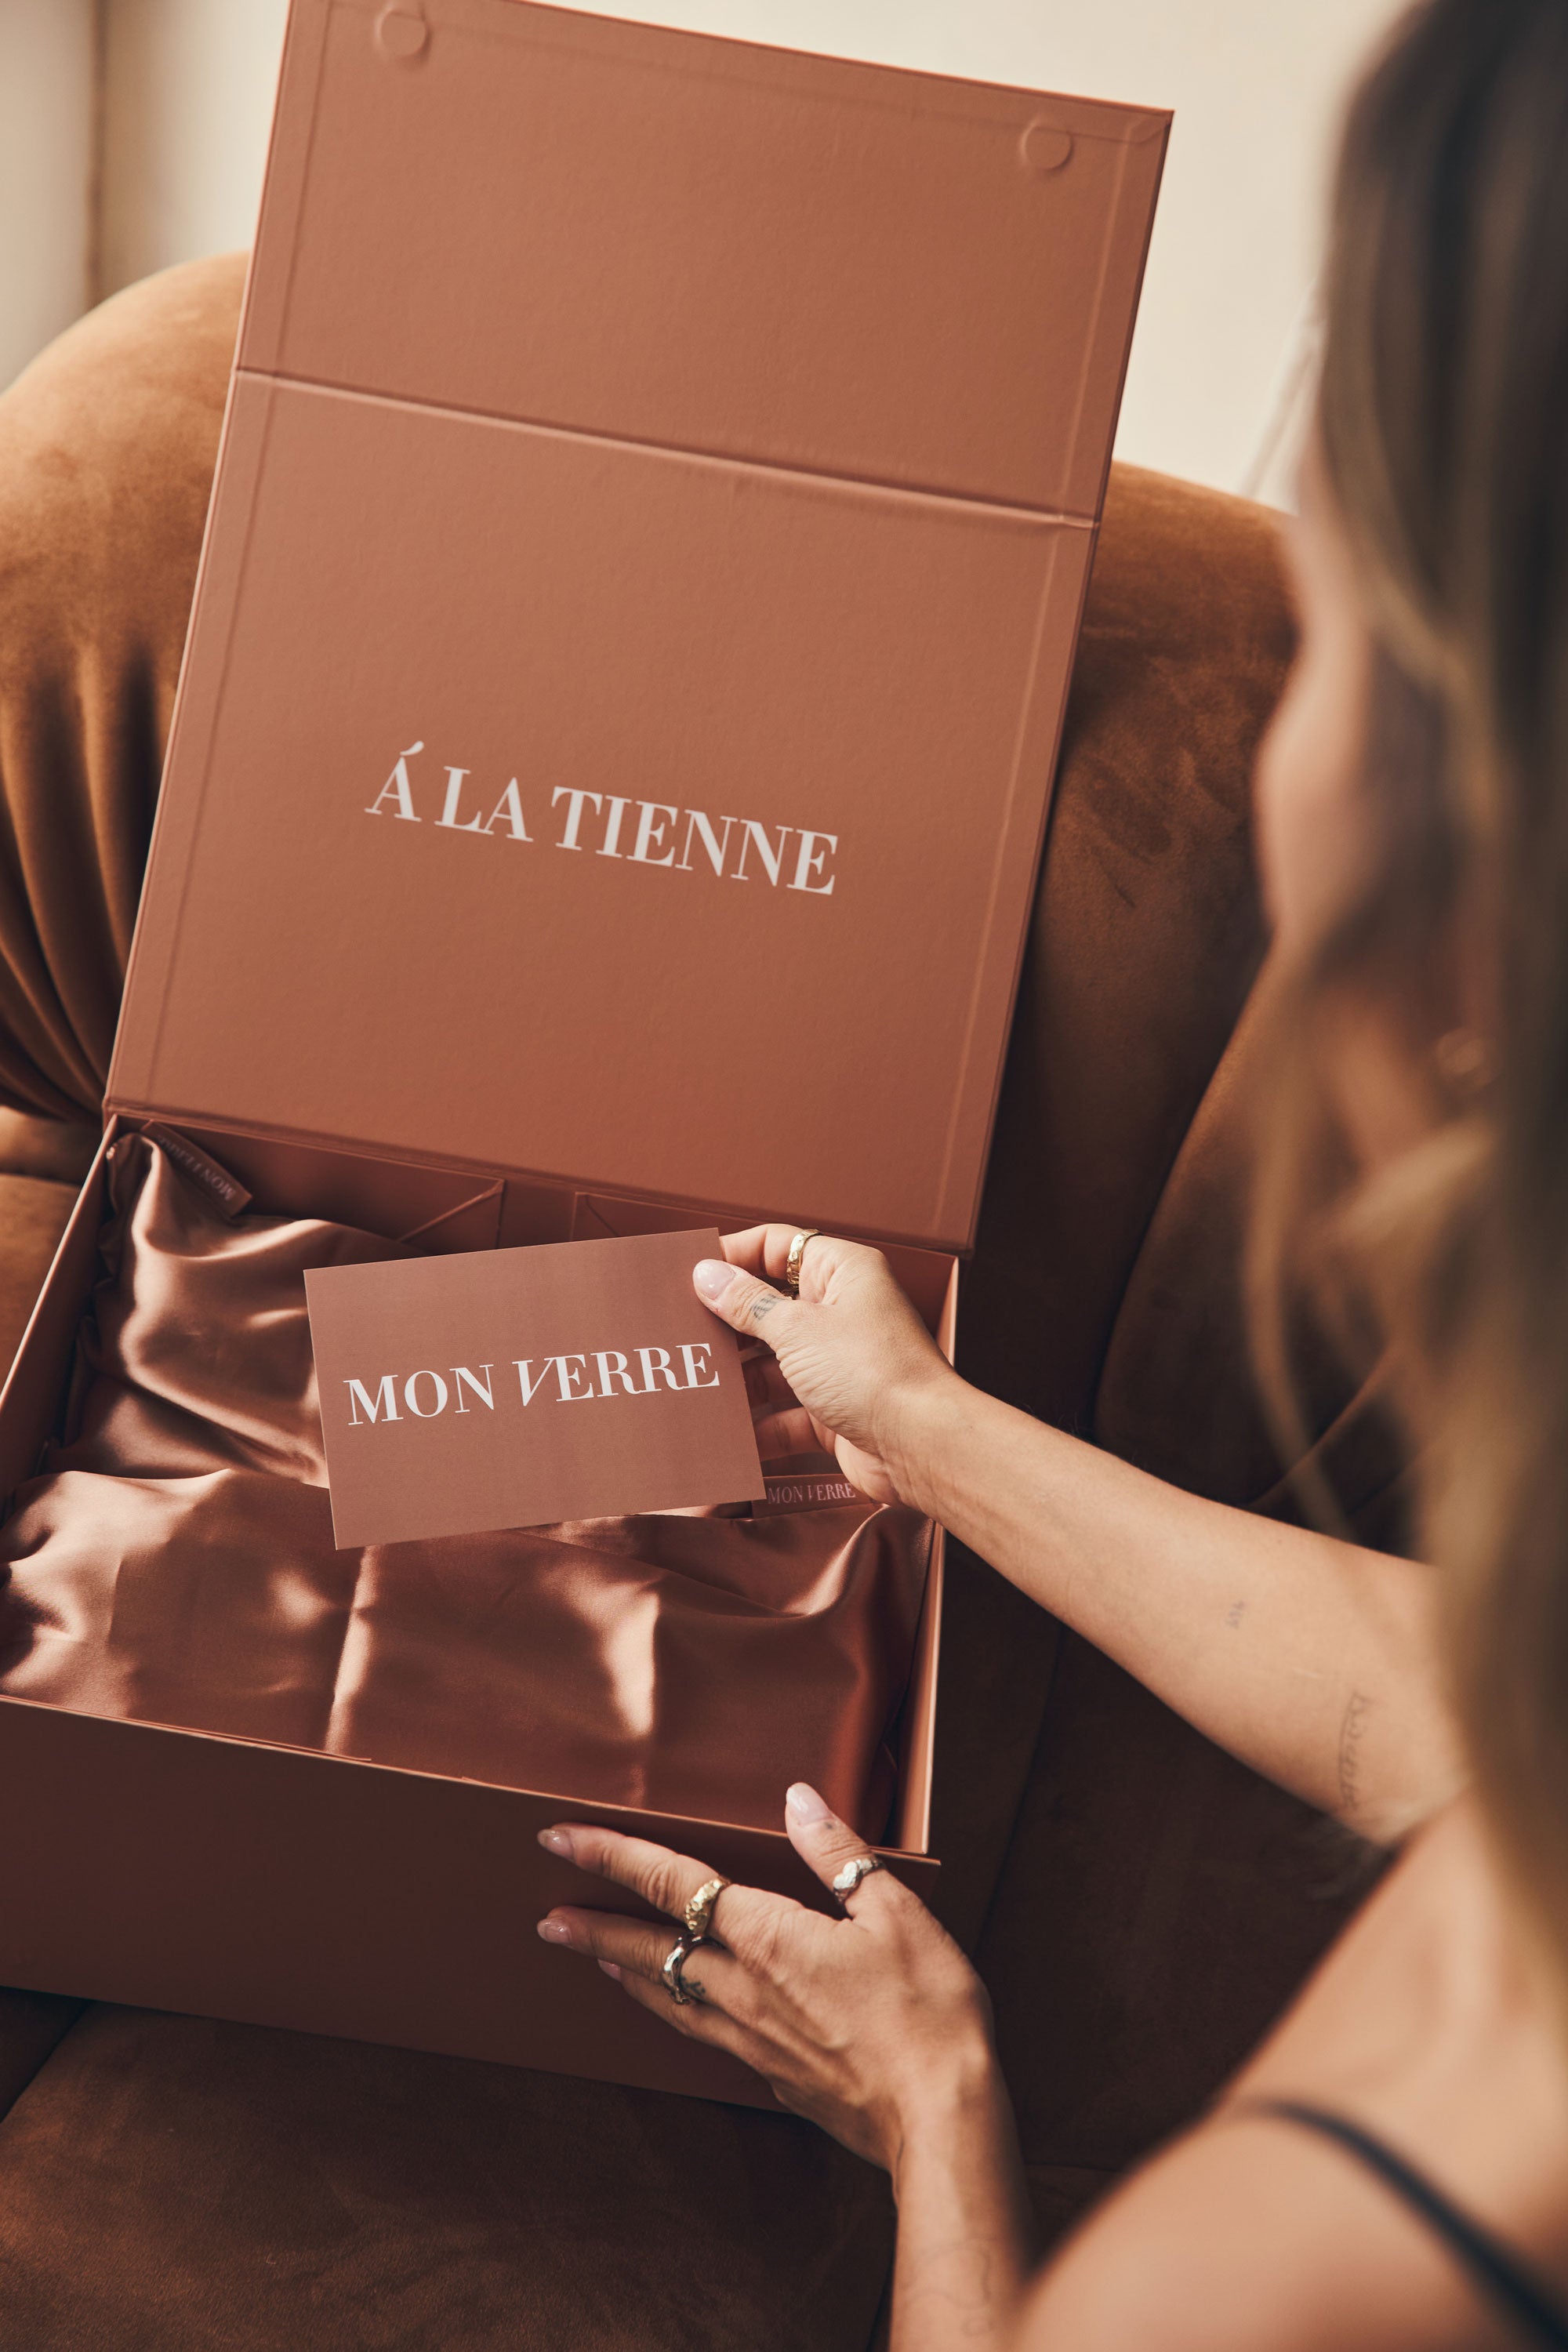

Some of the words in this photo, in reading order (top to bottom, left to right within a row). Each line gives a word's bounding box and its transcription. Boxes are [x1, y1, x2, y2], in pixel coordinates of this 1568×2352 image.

[365, 741, 424, 822] Á
[434, 765, 534, 842] LA
[551, 786, 838, 895] TIENNE
[343, 1364, 495, 1426] MON
[511, 1343, 720, 1406] VERRE
[768, 1486, 804, 1504] MON
[808, 1483, 856, 1501] VERRE
